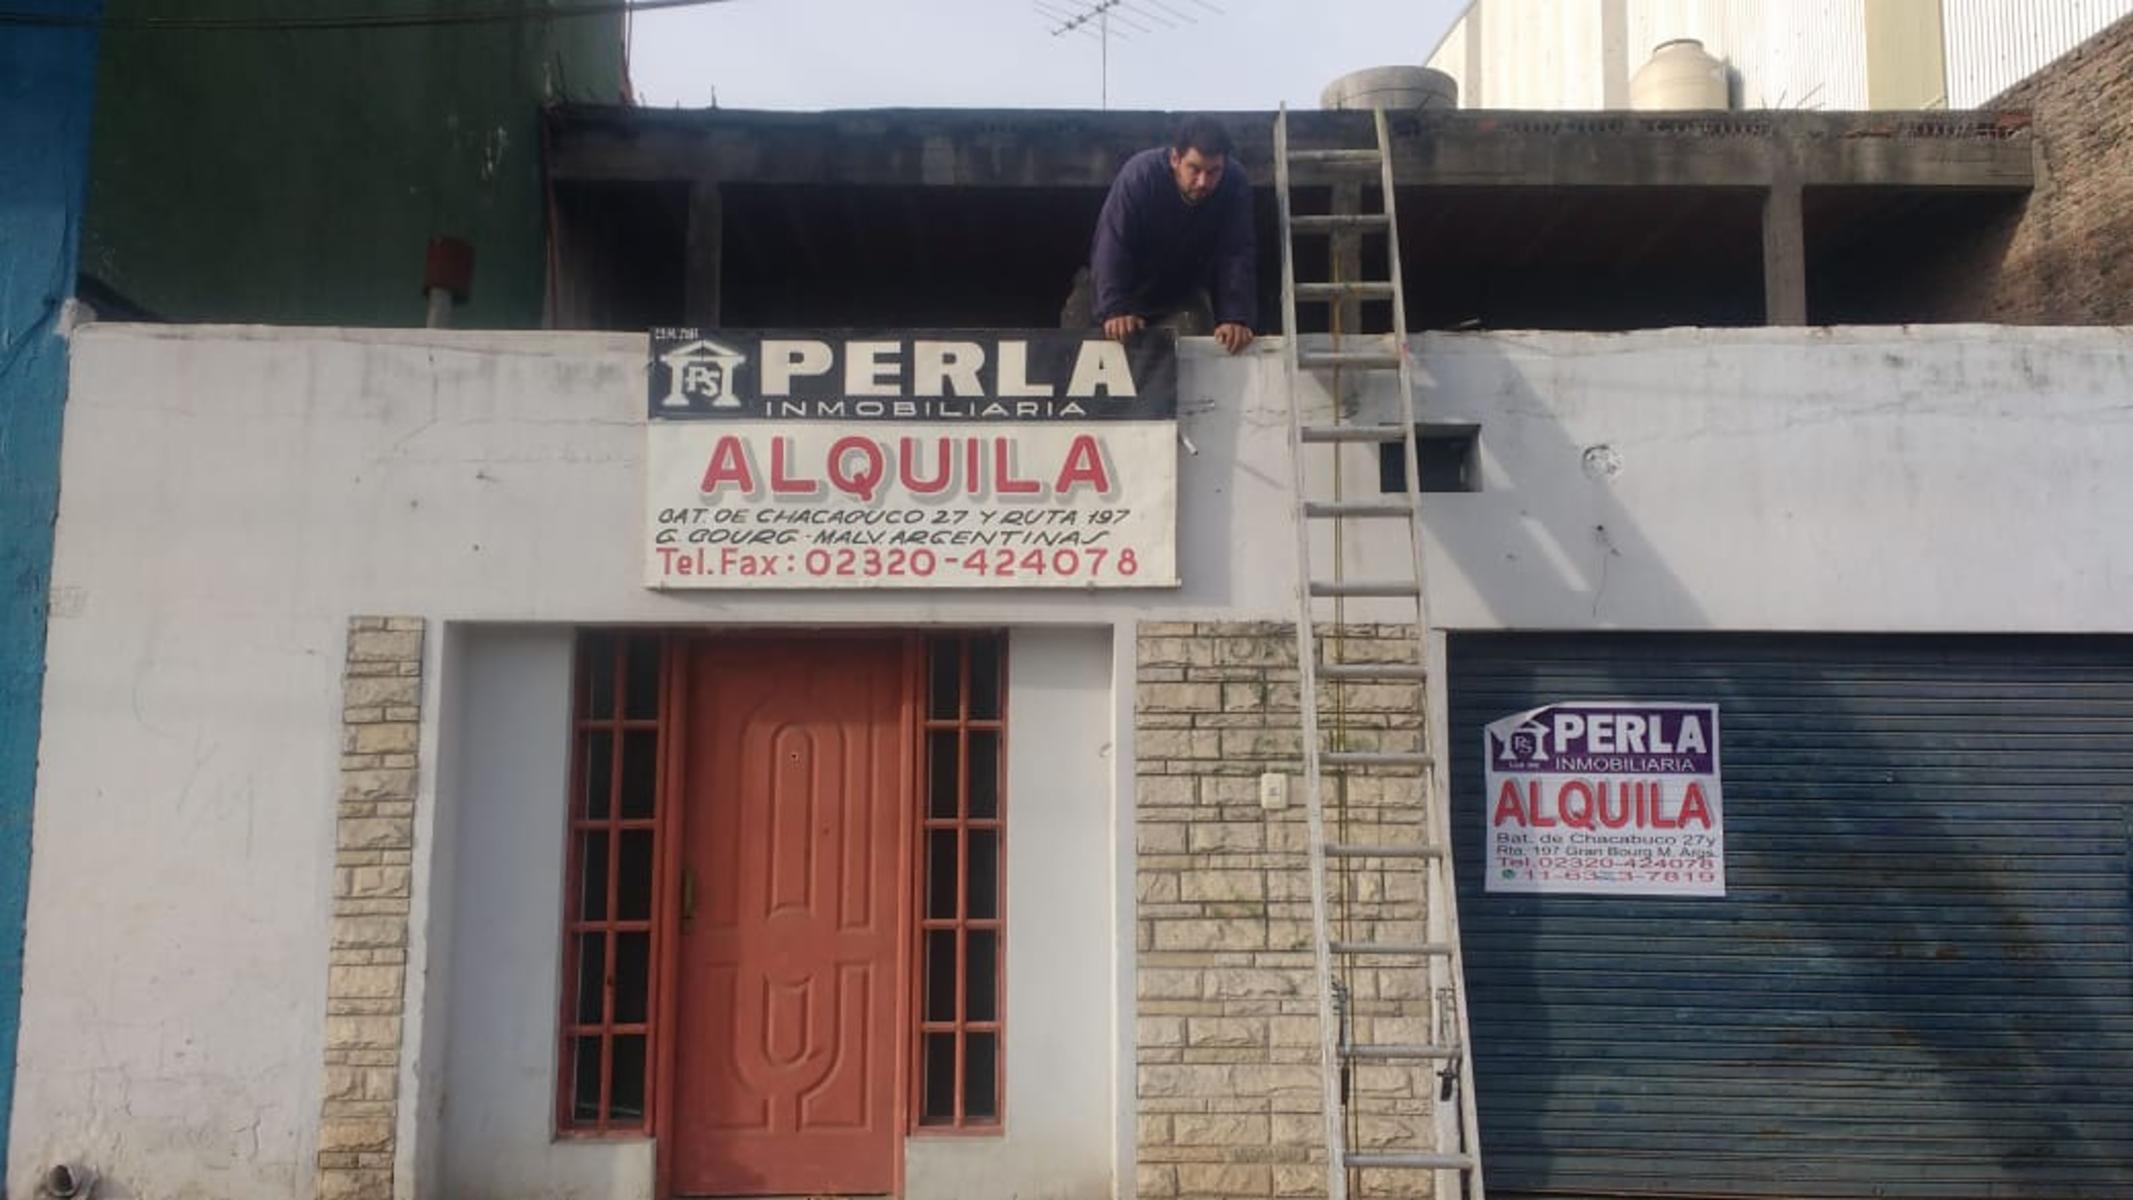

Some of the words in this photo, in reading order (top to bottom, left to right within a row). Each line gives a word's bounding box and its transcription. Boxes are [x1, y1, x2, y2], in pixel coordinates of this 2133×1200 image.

[760, 340, 1138, 397] PERLA
[766, 401, 1086, 417] INMOBILIARIA
[700, 435, 1116, 502] ALQUILA
[931, 509, 969, 525] 27
[1087, 509, 1132, 526] 197
[804, 547, 1138, 577] 02320-424078
[1554, 713, 1707, 754] PERLA
[1555, 757, 1696, 772] INMOBILIARIA
[1494, 779, 1714, 832] ALQUILA
[1540, 833, 1563, 844] de
[1570, 832, 1677, 845] Chacabuco
